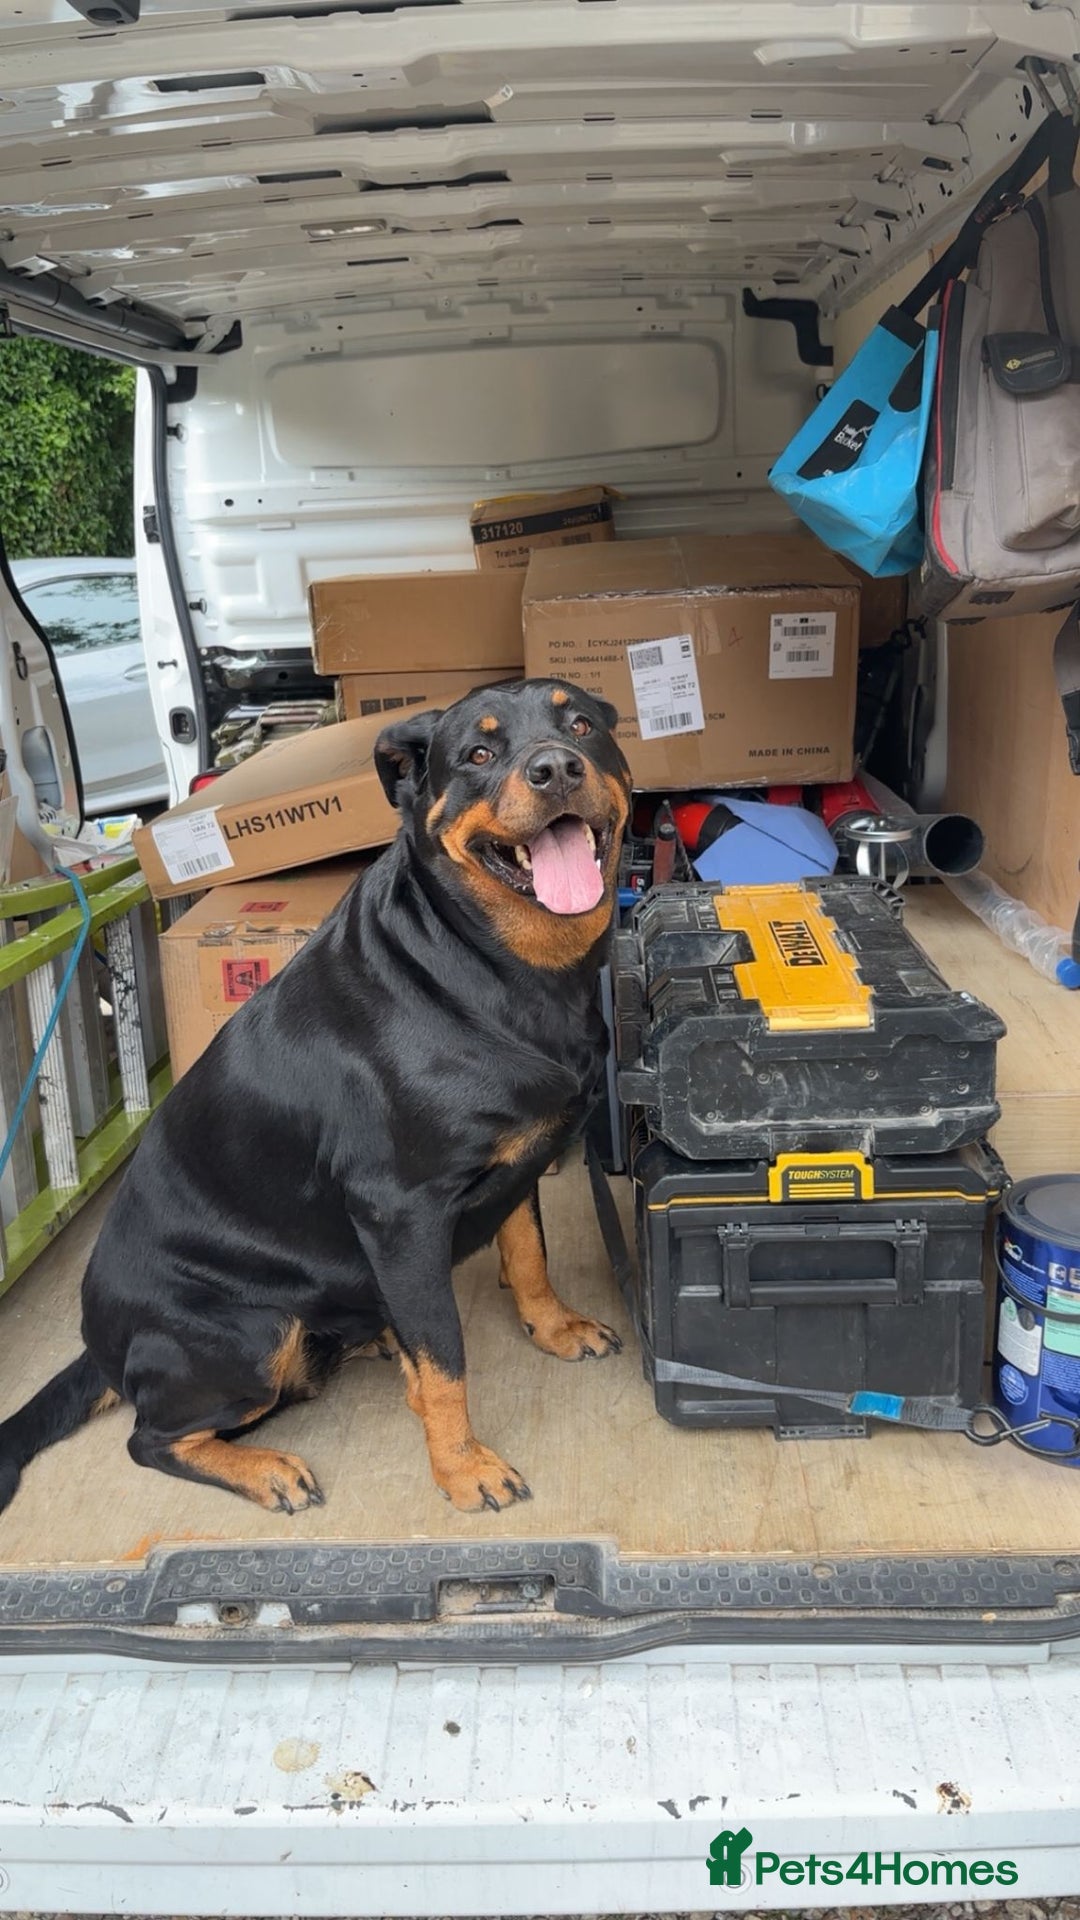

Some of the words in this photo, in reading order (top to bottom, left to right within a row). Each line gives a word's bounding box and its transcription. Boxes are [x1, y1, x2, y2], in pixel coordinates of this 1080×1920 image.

[480, 521, 524, 540] 317120
[550, 656, 567, 664] SKU
[748, 748, 779, 758] MADE
[782, 747, 794, 757] IN
[796, 745, 831, 756] CHINA
[223, 795, 343, 842] LHS11WTV1
[770, 920, 824, 967] DEWALT
[788, 1169, 855, 1180] TOUGHSYSTEM
